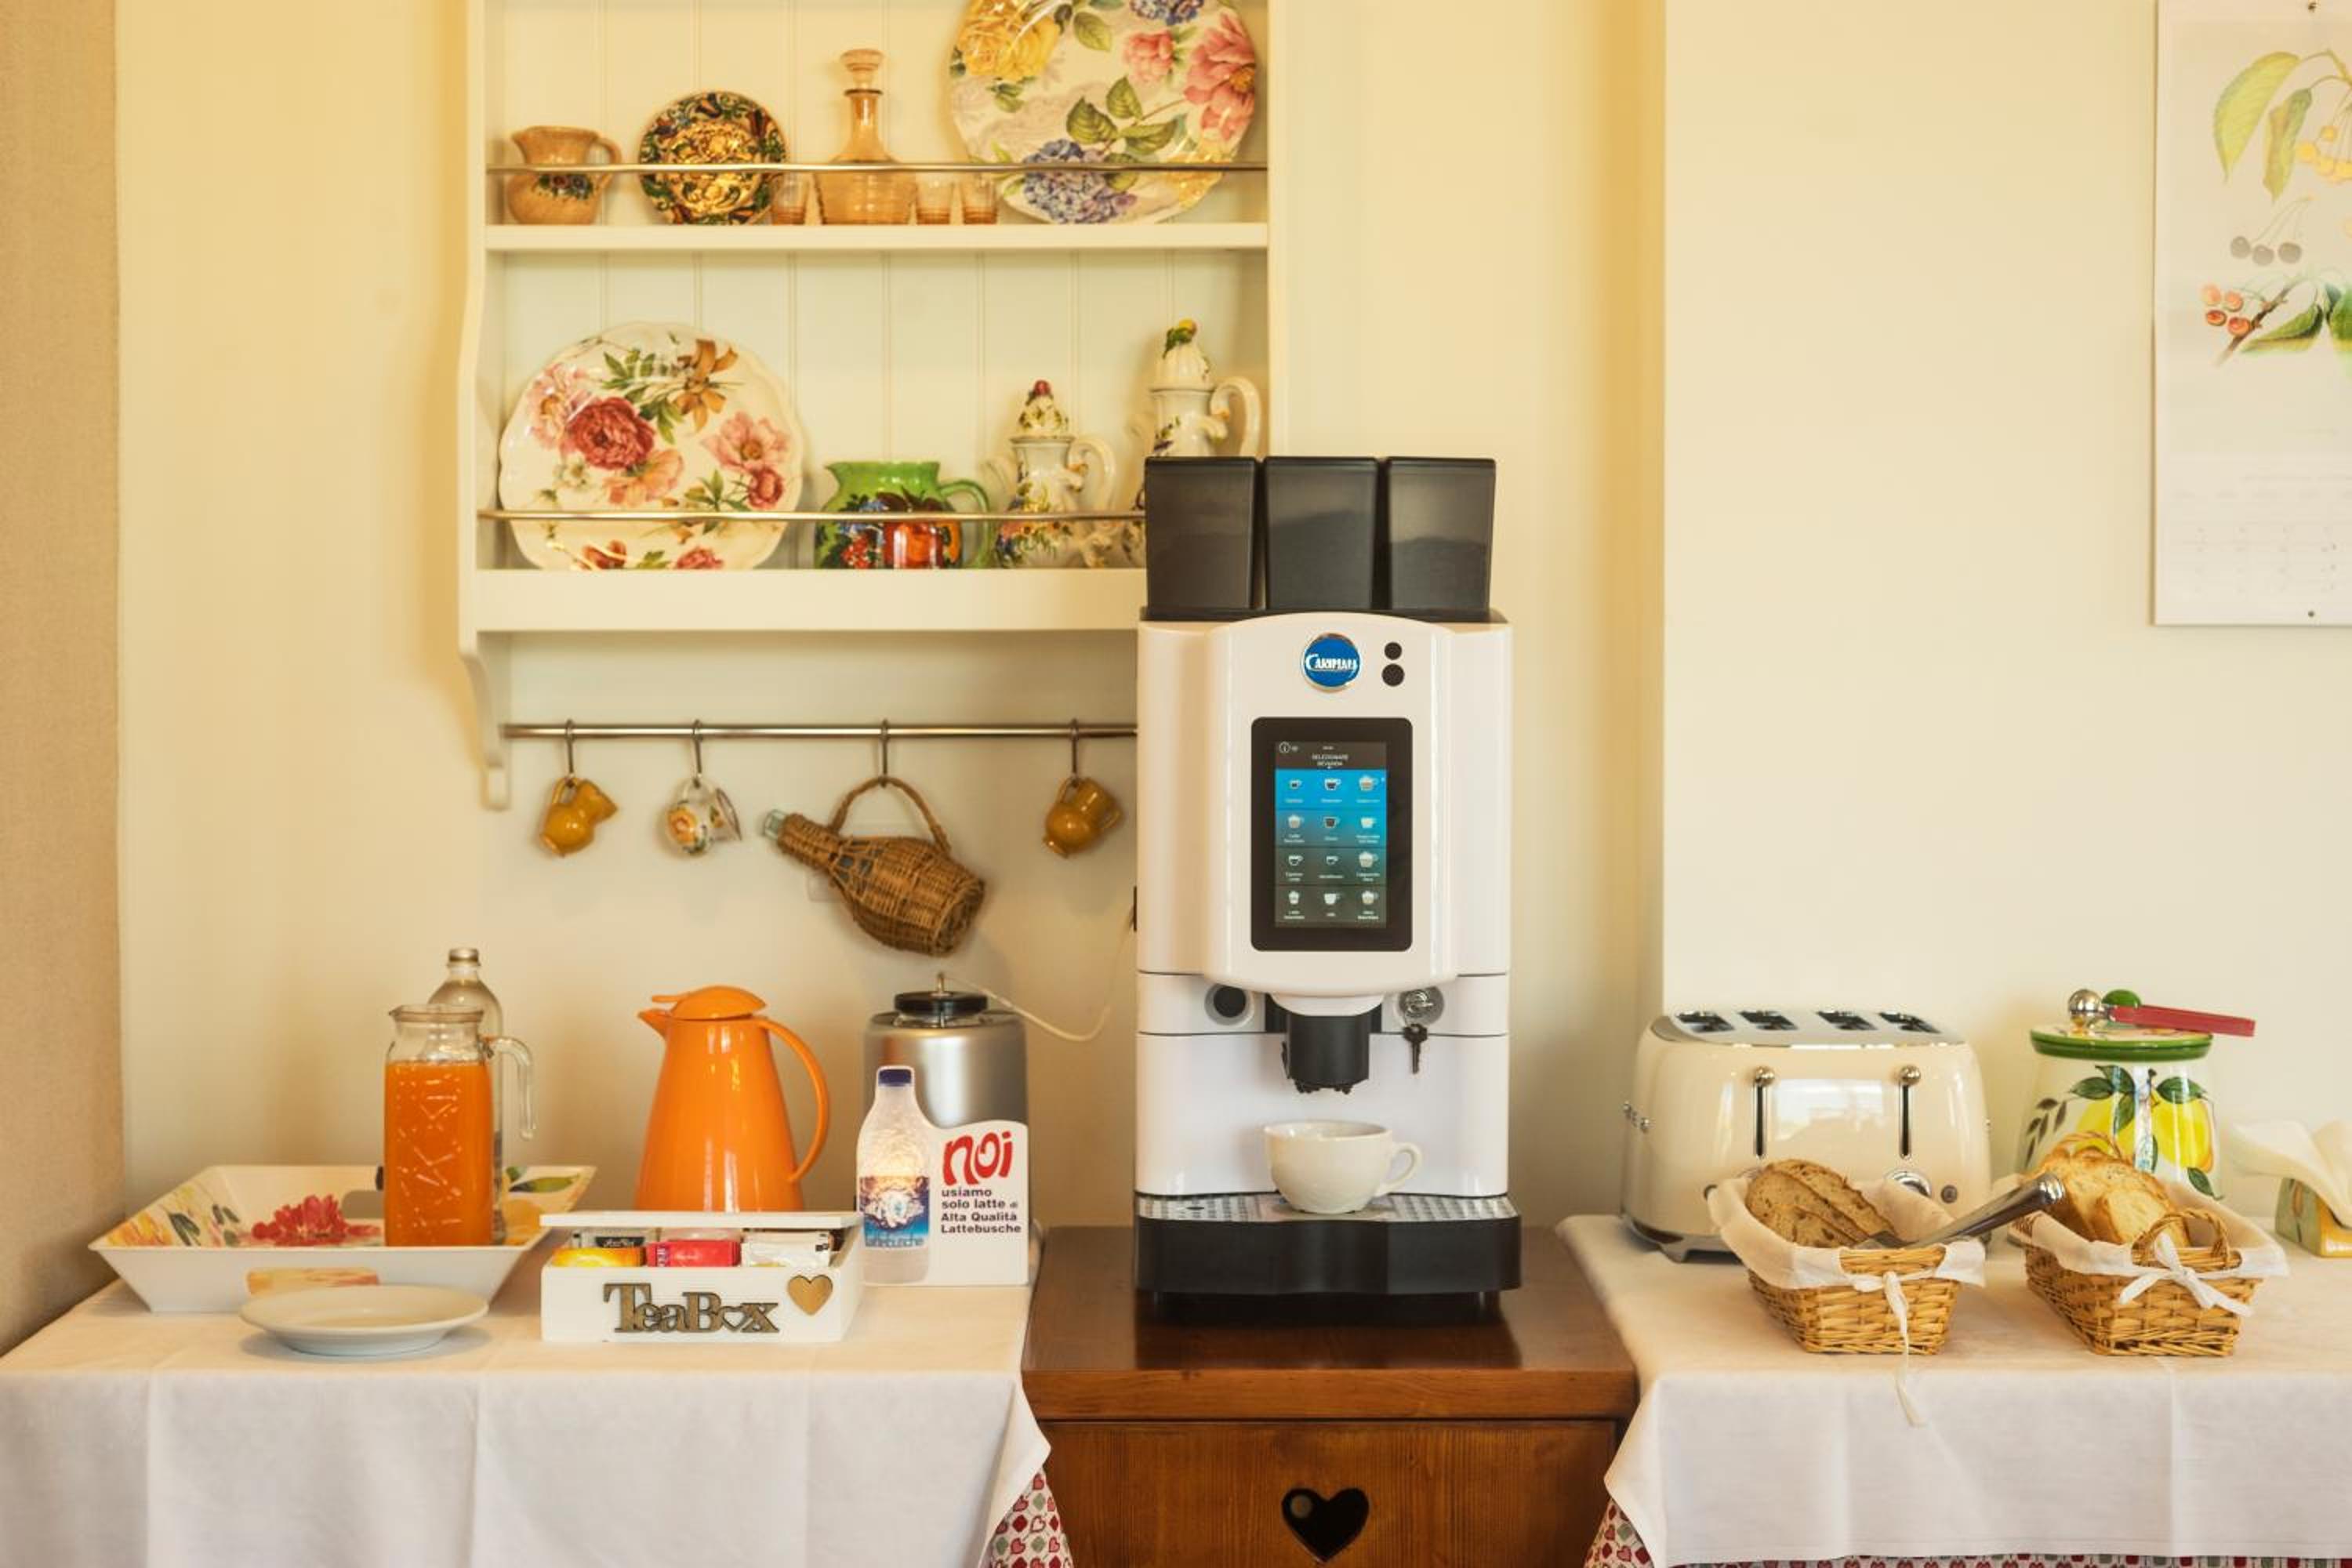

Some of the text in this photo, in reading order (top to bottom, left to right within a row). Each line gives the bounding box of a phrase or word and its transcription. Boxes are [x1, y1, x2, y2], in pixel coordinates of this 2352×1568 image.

[942, 1131, 1013, 1185] noi
[942, 1187, 992, 1197] usiamo
[942, 1199, 970, 1208] solo
[975, 1199, 1005, 1208] latte
[941, 1211, 1018, 1221] Alta Qualità
[941, 1224, 1022, 1233] Lattebusche
